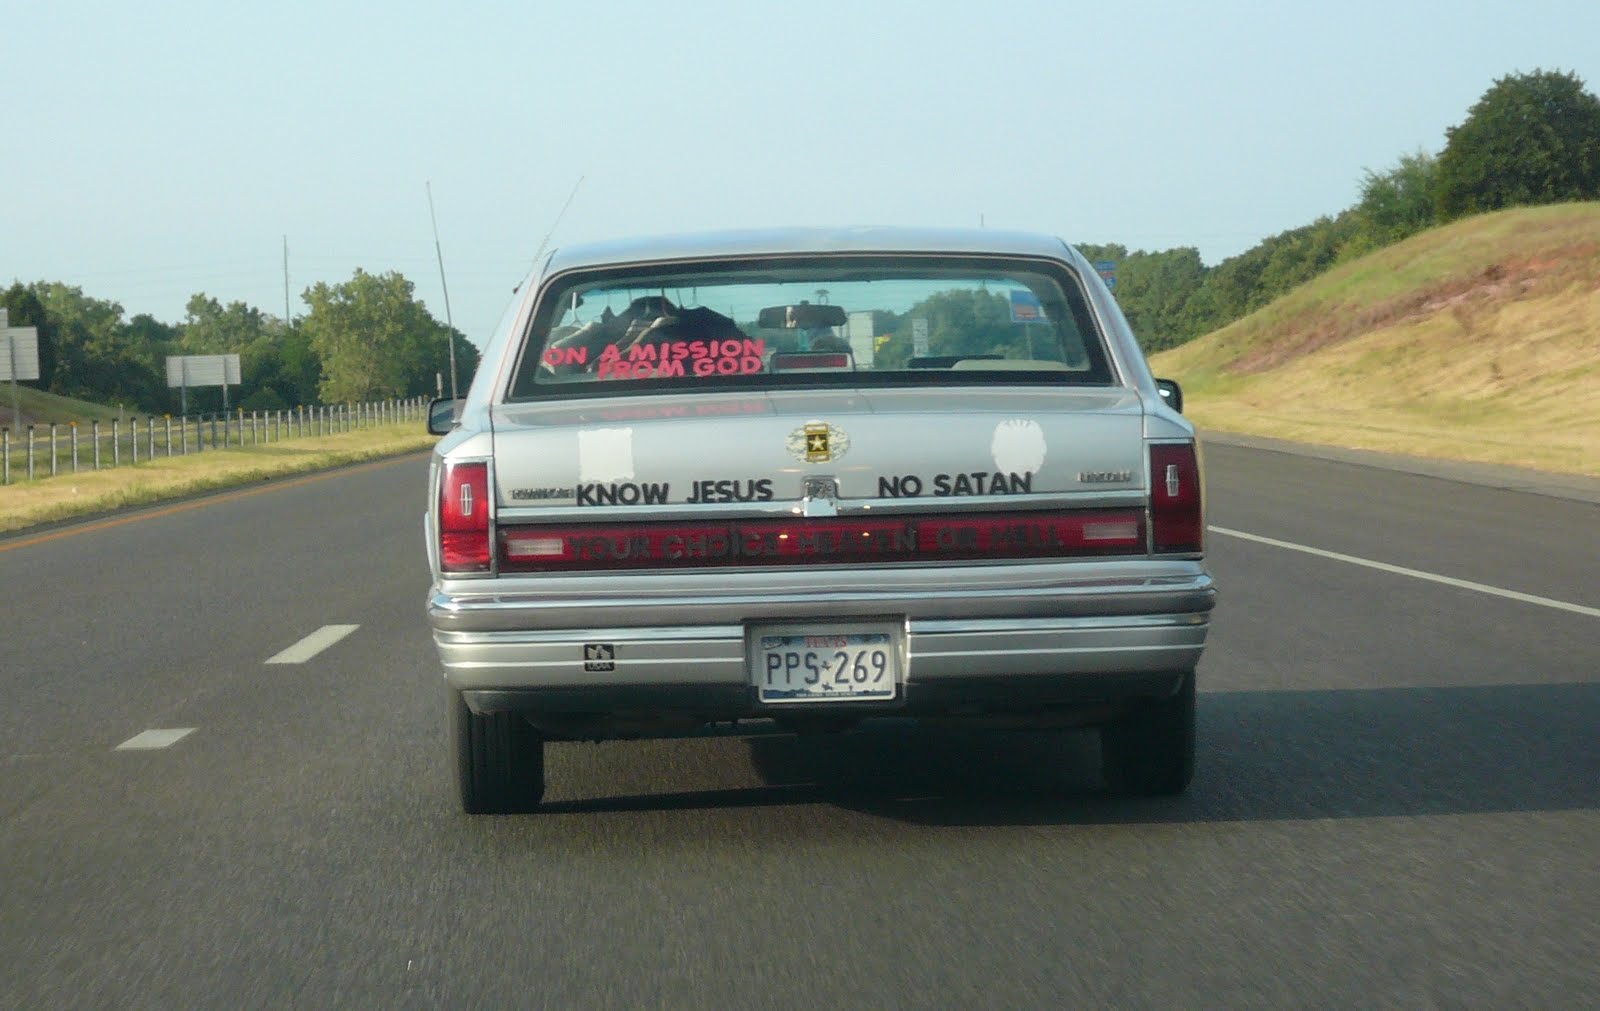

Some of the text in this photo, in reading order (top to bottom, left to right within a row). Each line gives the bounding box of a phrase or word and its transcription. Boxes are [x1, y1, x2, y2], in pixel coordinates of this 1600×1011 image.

[543, 338, 765, 366] ON A MISSION
[597, 356, 763, 380] FROM GOD
[576, 482, 669, 506] KNOW
[686, 479, 773, 503] JESUS
[878, 475, 922, 497] NO
[934, 471, 1032, 496] SATAN
[568, 524, 1064, 560] YOUR CHOICE HEAVEN OR HELL
[805, 636, 848, 649] TEXAS
[766, 650, 886, 684] PPS 269
